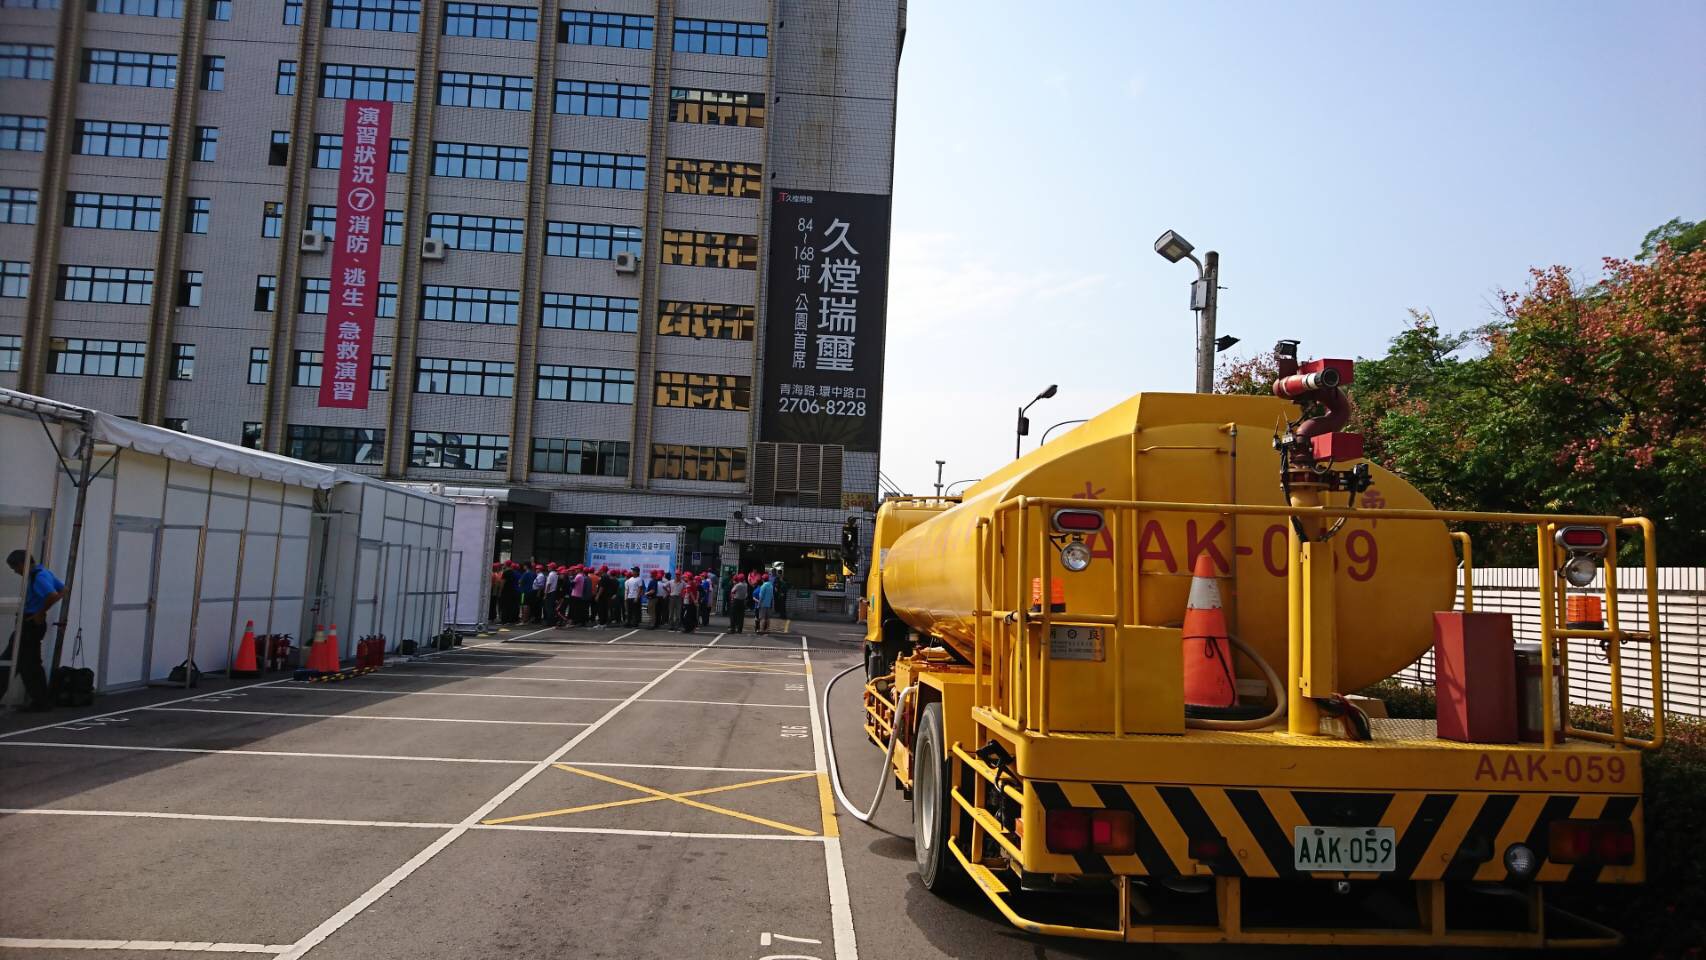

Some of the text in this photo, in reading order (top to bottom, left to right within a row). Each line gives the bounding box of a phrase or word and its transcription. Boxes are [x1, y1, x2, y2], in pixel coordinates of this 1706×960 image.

[815, 217, 861, 372] 久樘瑞璽
[792, 293, 809, 369] 公園首席
[779, 397, 866, 417] 2706-8228
[1474, 753, 1626, 784] AAK-059
